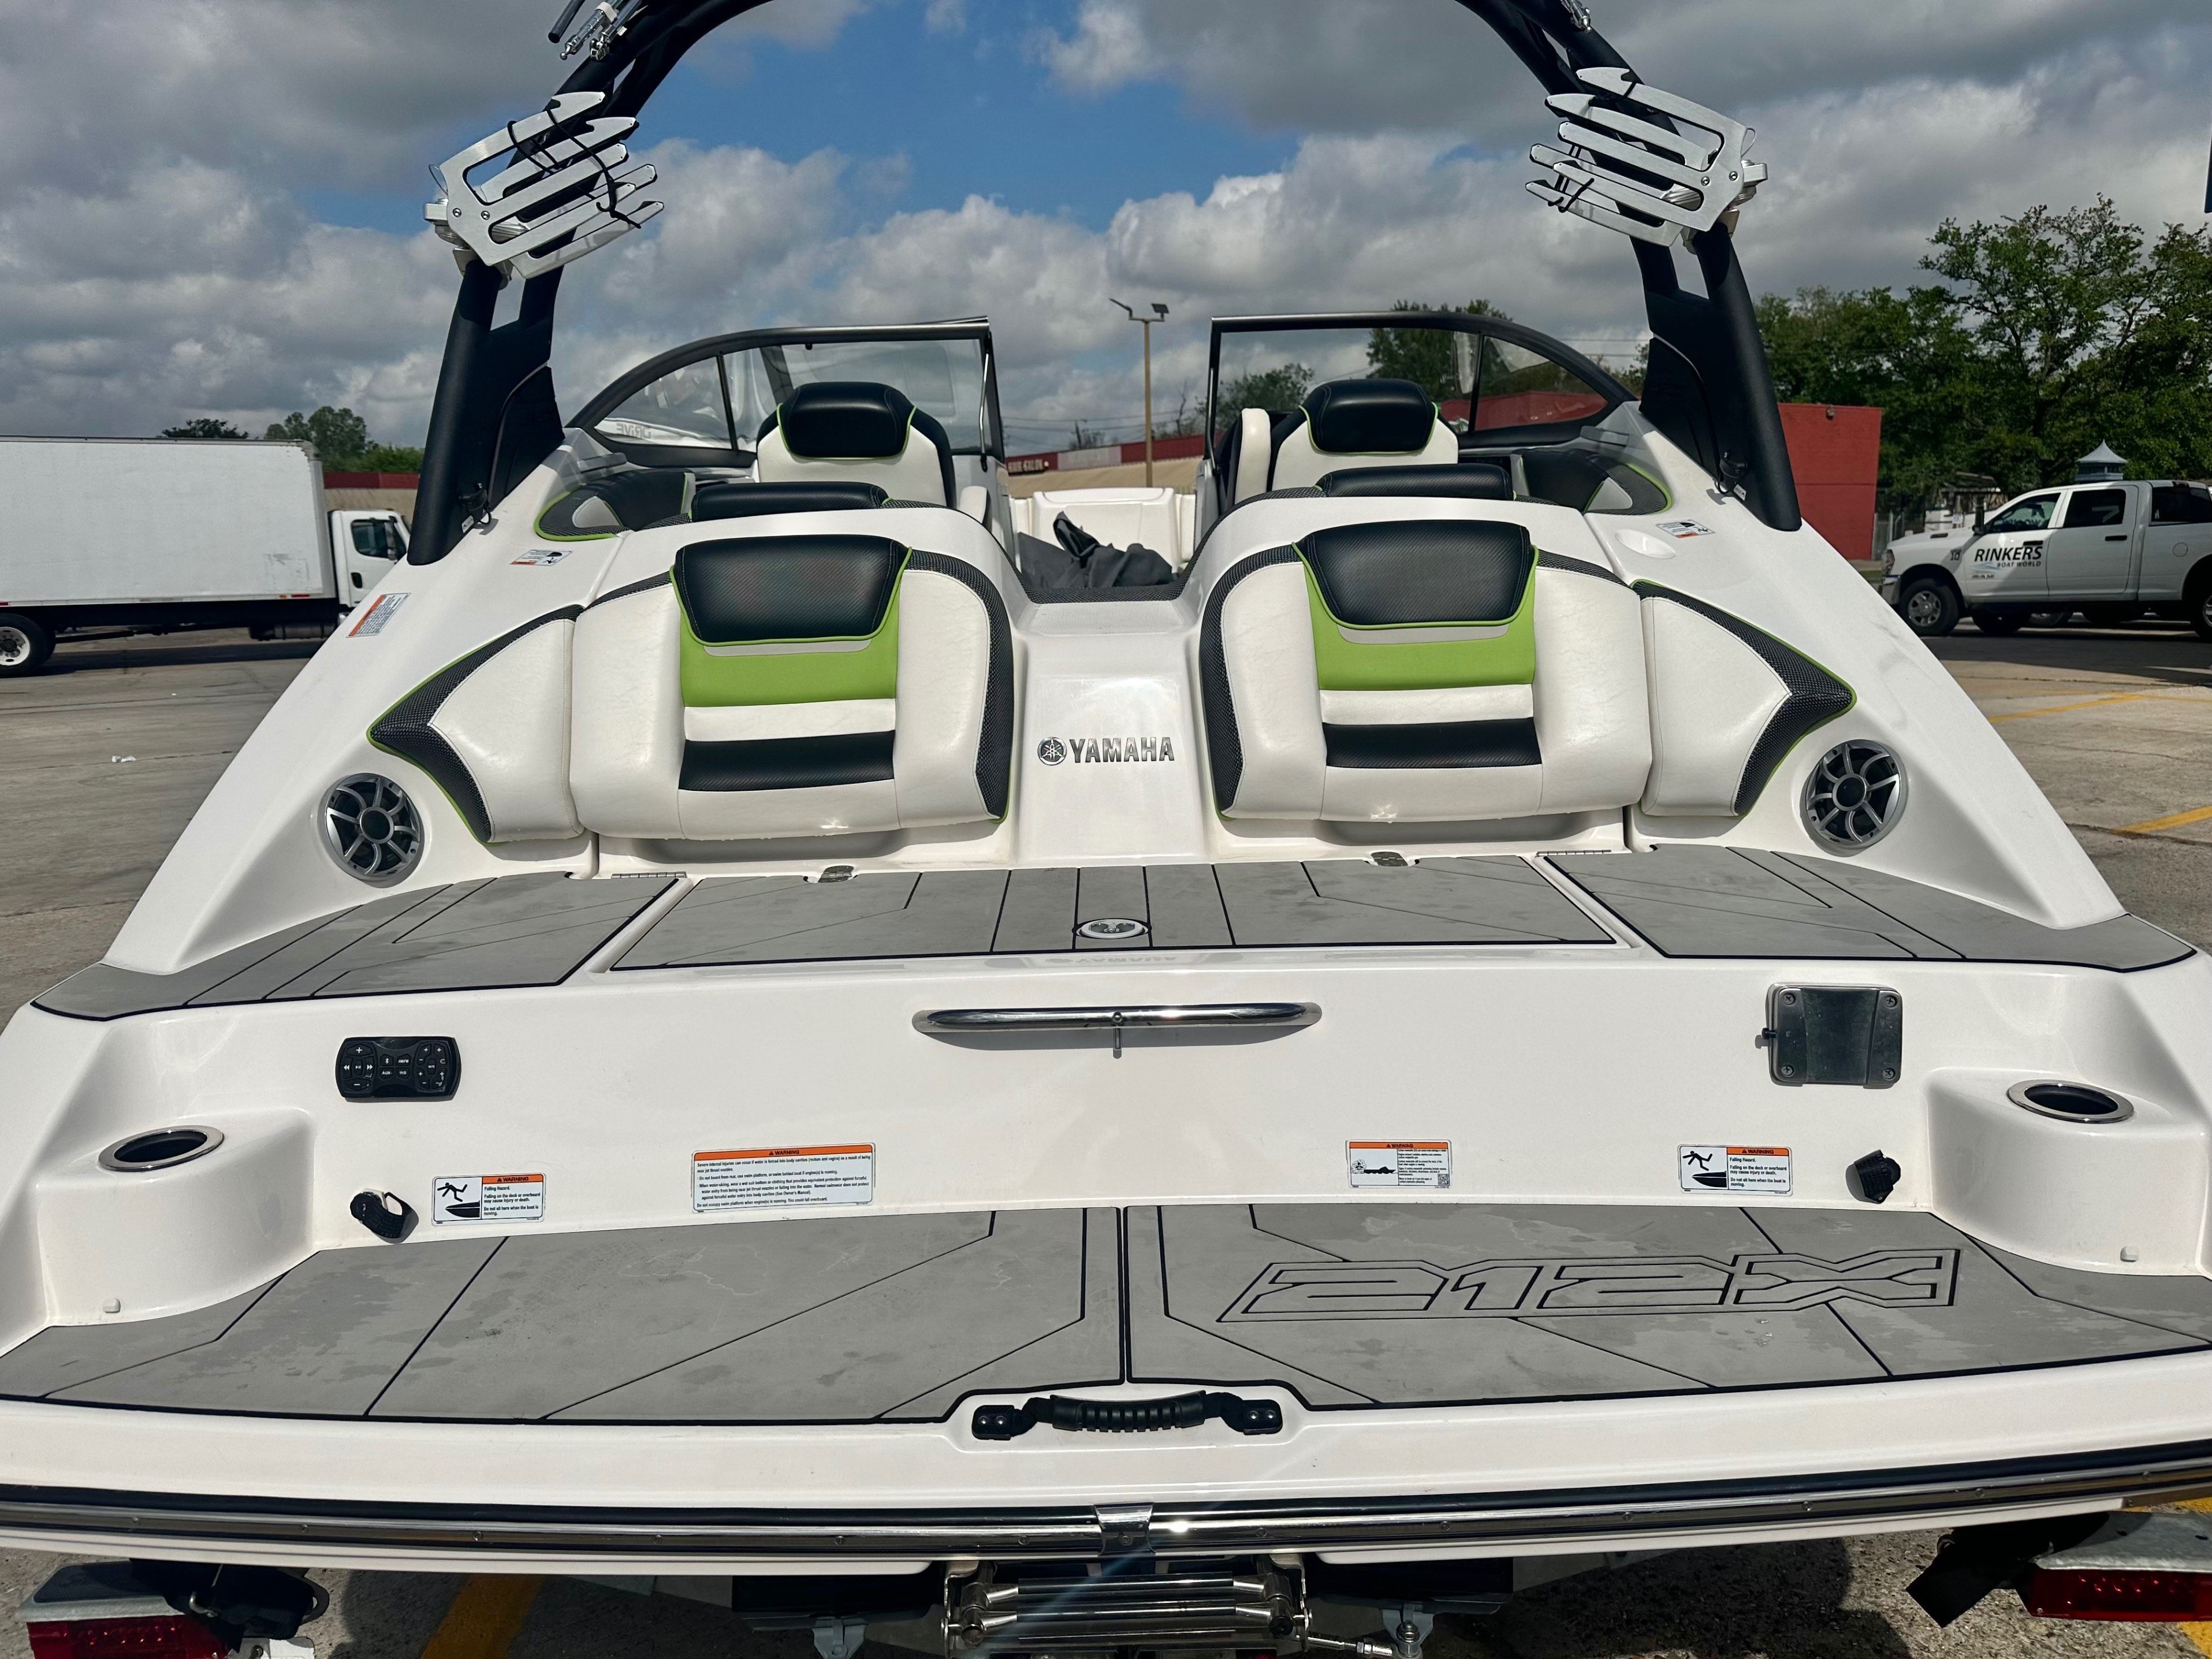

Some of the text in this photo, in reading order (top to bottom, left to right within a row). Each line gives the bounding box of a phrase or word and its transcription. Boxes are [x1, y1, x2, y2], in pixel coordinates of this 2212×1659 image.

[1975, 546, 2043, 561] RINKERS
[1069, 736, 1175, 763] YAMAHA
[1216, 1249, 1961, 1323] 212X
